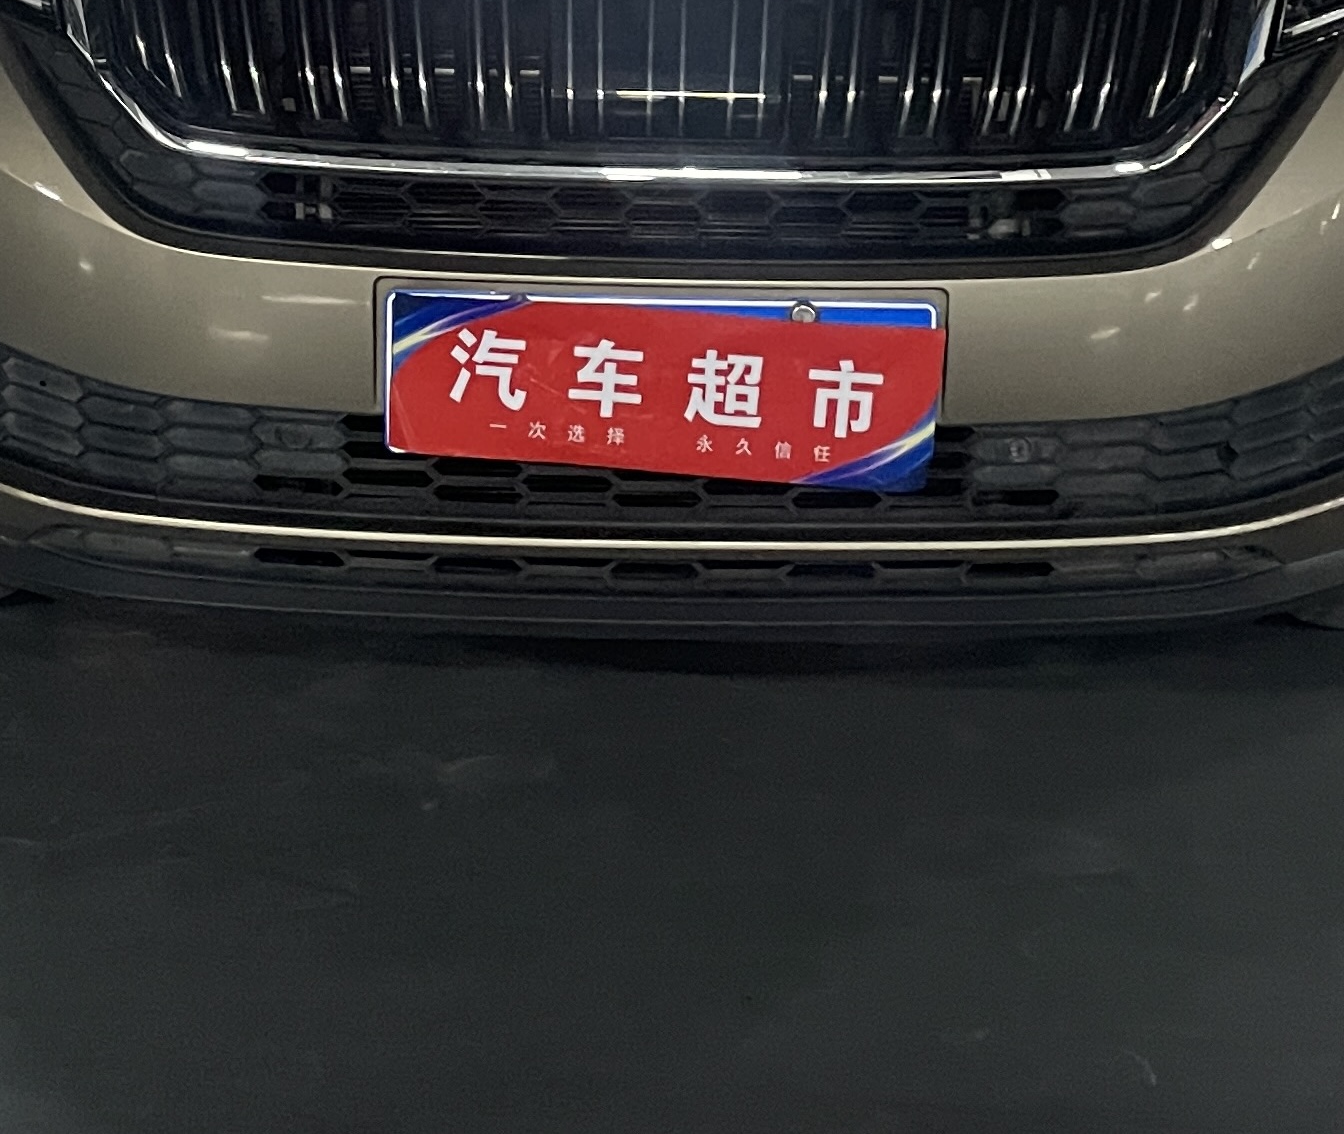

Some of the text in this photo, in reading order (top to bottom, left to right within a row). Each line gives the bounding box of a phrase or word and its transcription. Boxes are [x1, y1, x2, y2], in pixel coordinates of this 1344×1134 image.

[449, 328, 884, 439] 汽车超市
[489, 421, 832, 463] 一次选择 永久信任
